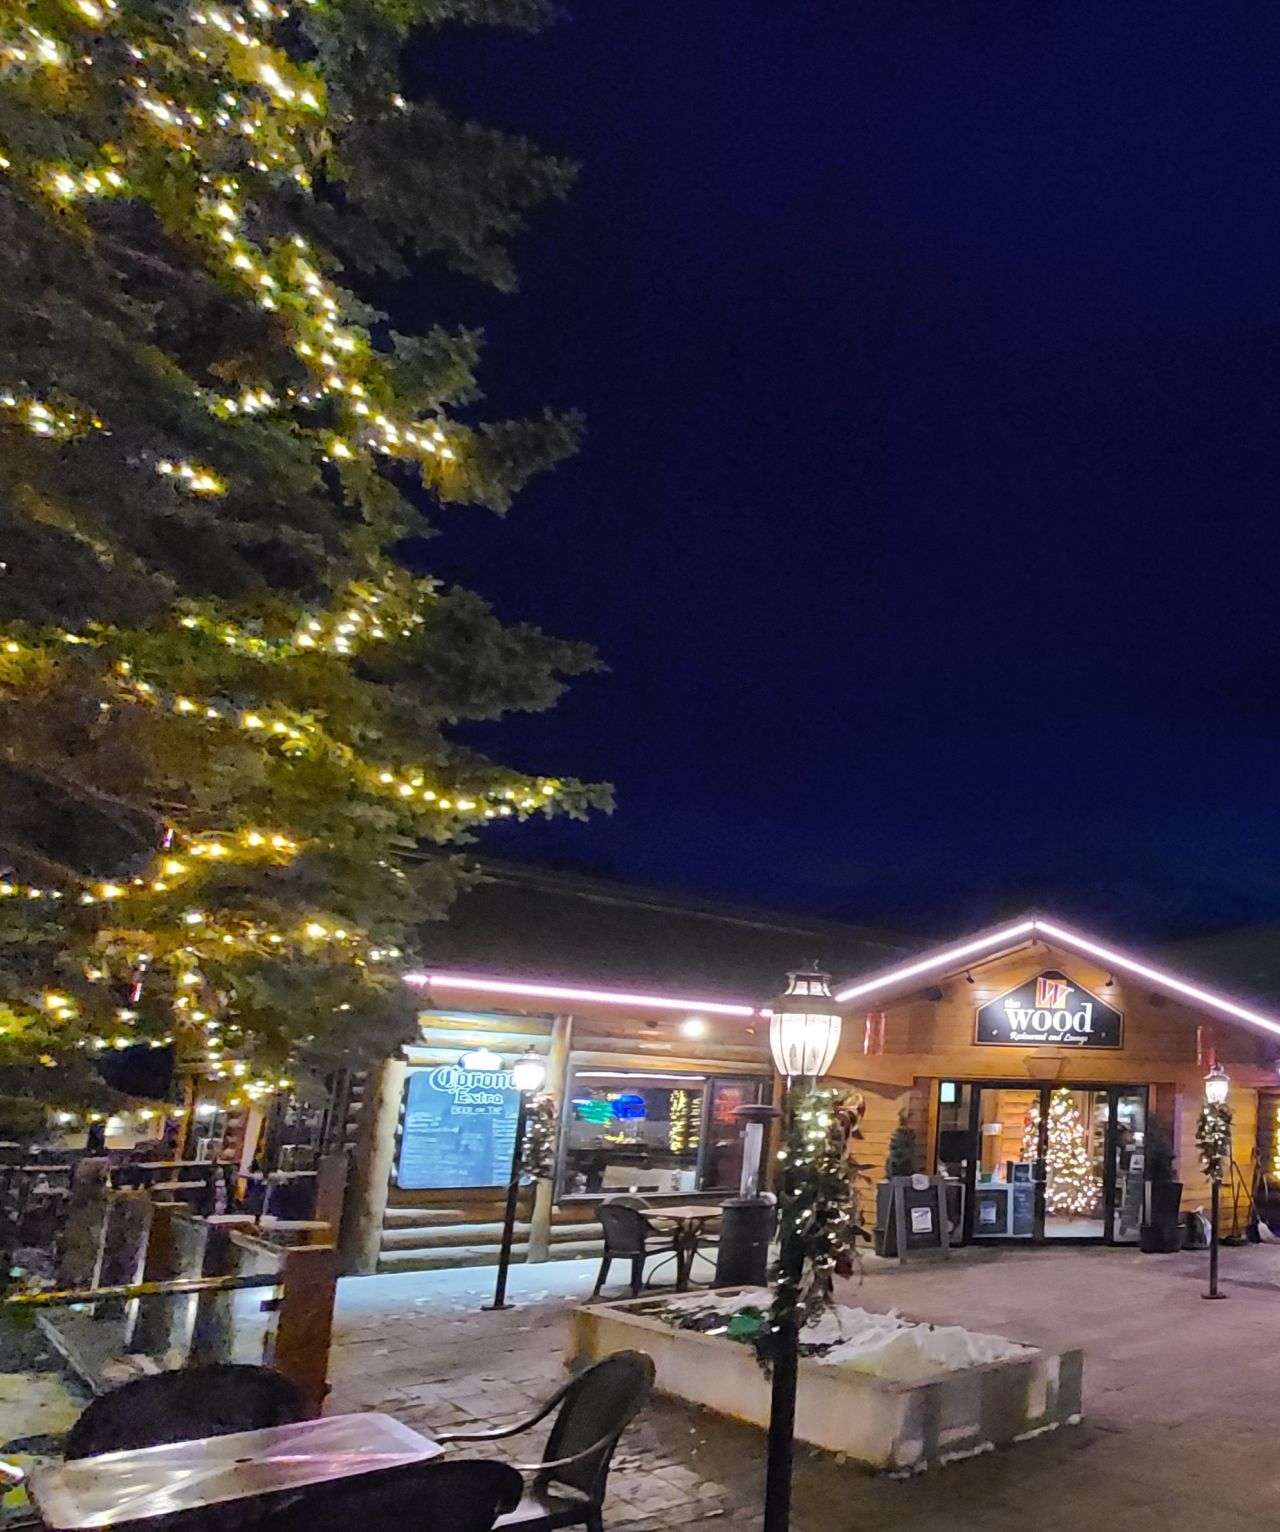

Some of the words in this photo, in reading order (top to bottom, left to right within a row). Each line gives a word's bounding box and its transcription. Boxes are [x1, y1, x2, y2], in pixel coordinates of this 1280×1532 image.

[1004, 998, 1021, 1009] the
[1004, 1003, 1094, 1033] wood
[1009, 1031, 1047, 1041] Restaurant
[1048, 1032, 1063, 1041] and
[1063, 1033, 1088, 1045] Lounge
[454, 1087, 504, 1104] Extra
